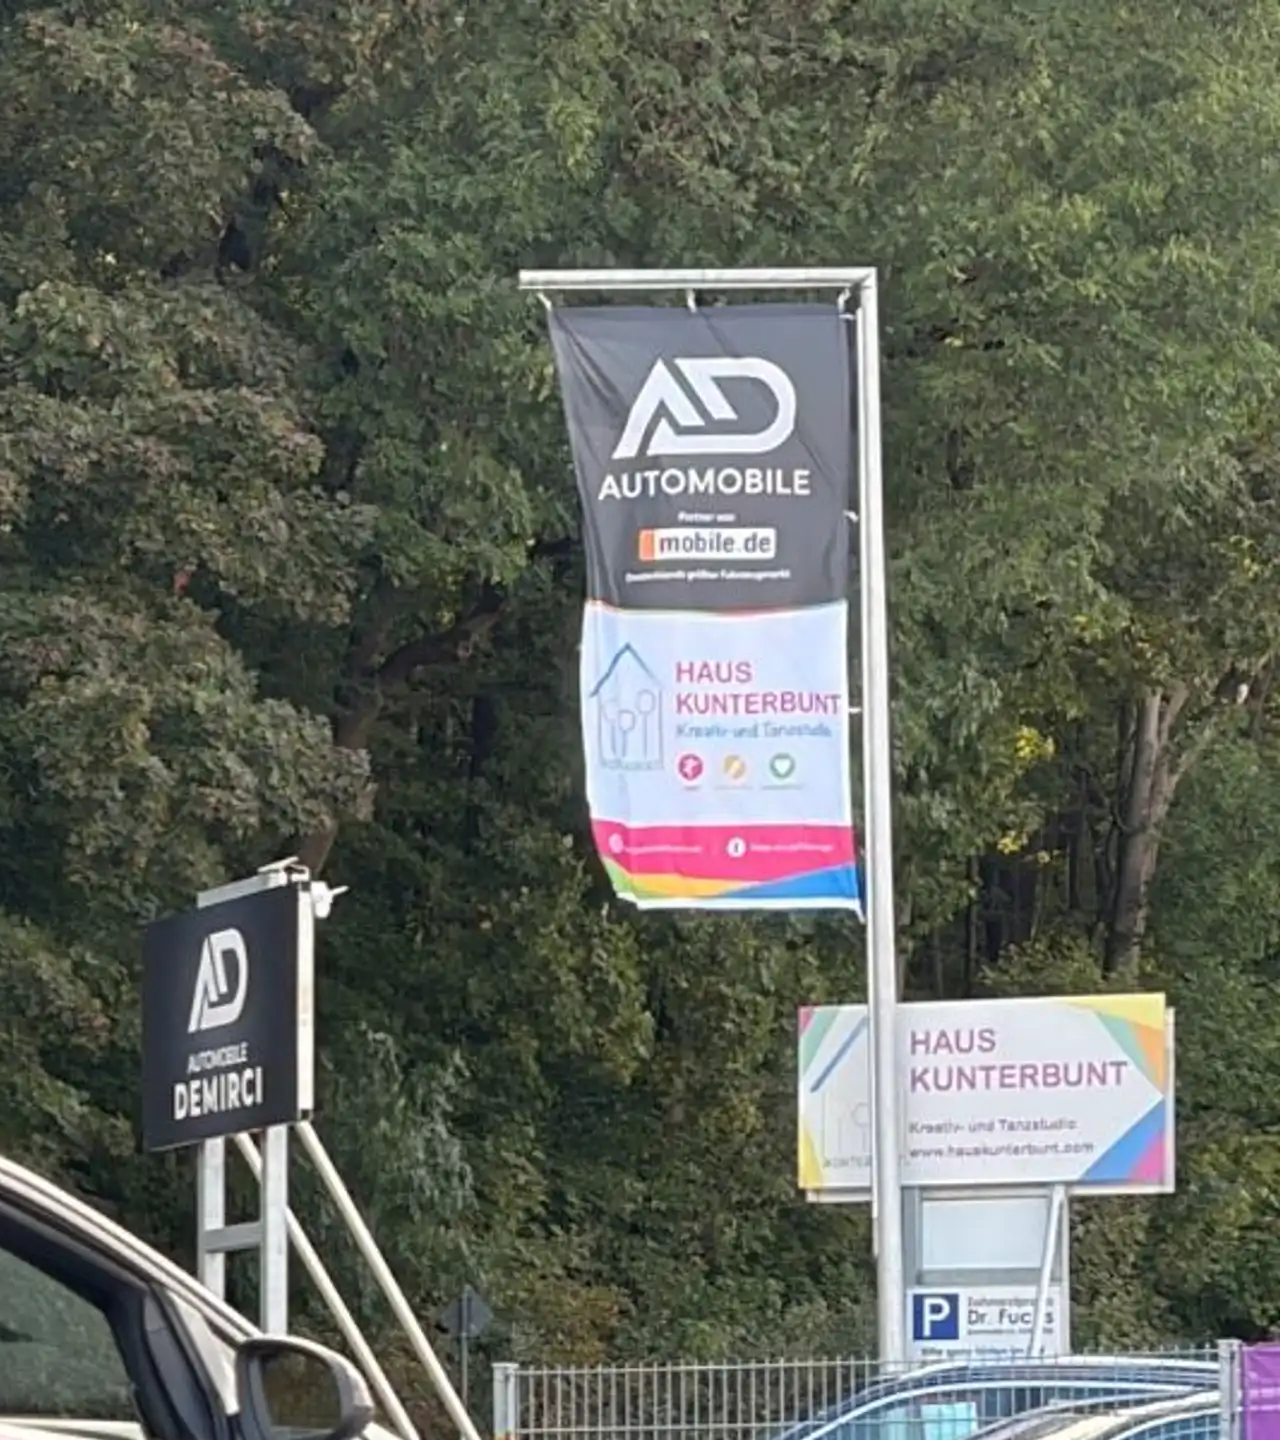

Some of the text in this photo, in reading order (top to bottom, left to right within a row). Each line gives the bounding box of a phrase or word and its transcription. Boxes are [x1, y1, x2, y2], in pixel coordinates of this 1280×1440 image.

[598, 468, 810, 500] AUTOMOBILE
[659, 532, 771, 554] mobile.de
[675, 661, 752, 683] HAUS
[675, 692, 840, 714] KUNTERBUNT
[910, 1029, 997, 1055] HAUS
[910, 1060, 1128, 1093] KUNTERBUNT
[174, 1066, 264, 1120] DEMIRCI
[968, 1118, 995, 1133] und
[922, 1297, 951, 1338] P
[998, 1308, 1055, 1325] Fucs
